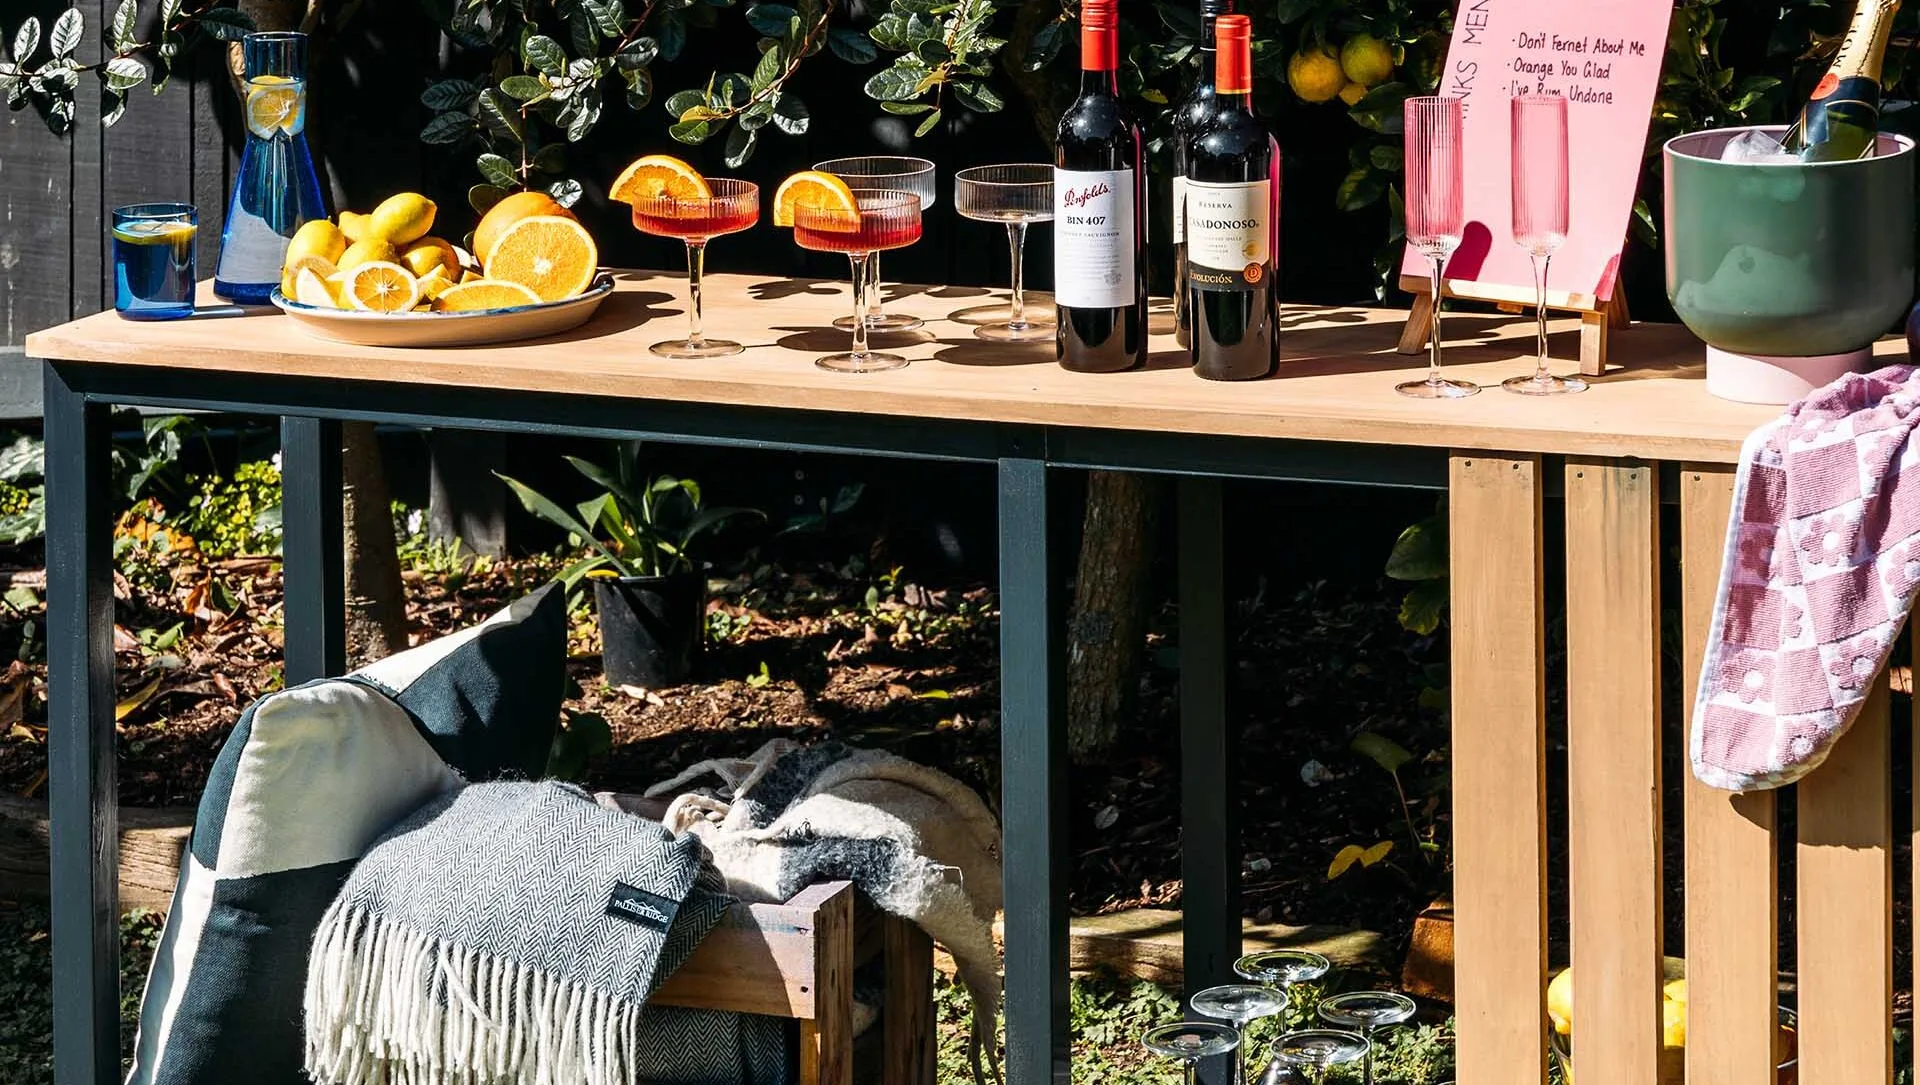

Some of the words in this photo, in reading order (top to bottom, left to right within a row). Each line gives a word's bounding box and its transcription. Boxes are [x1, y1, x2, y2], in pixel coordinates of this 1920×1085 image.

[1518, 32, 1546, 49] Don't
[1552, 34, 1588, 53] Fernet
[1592, 38, 1624, 55] About
[1629, 41, 1645, 56] Me
[1513, 57, 1554, 81] Orange
[1561, 60, 1577, 77] You
[1583, 61, 1611, 79] Glad
[1537, 82, 1561, 96] Rum
[1569, 84, 1613, 104] Undone
[1066, 216, 1084, 225] BIN
[1085, 216, 1106, 226] 407
[614, 899, 645, 916] PALLISER
[645, 910, 669, 923] RIDGE
